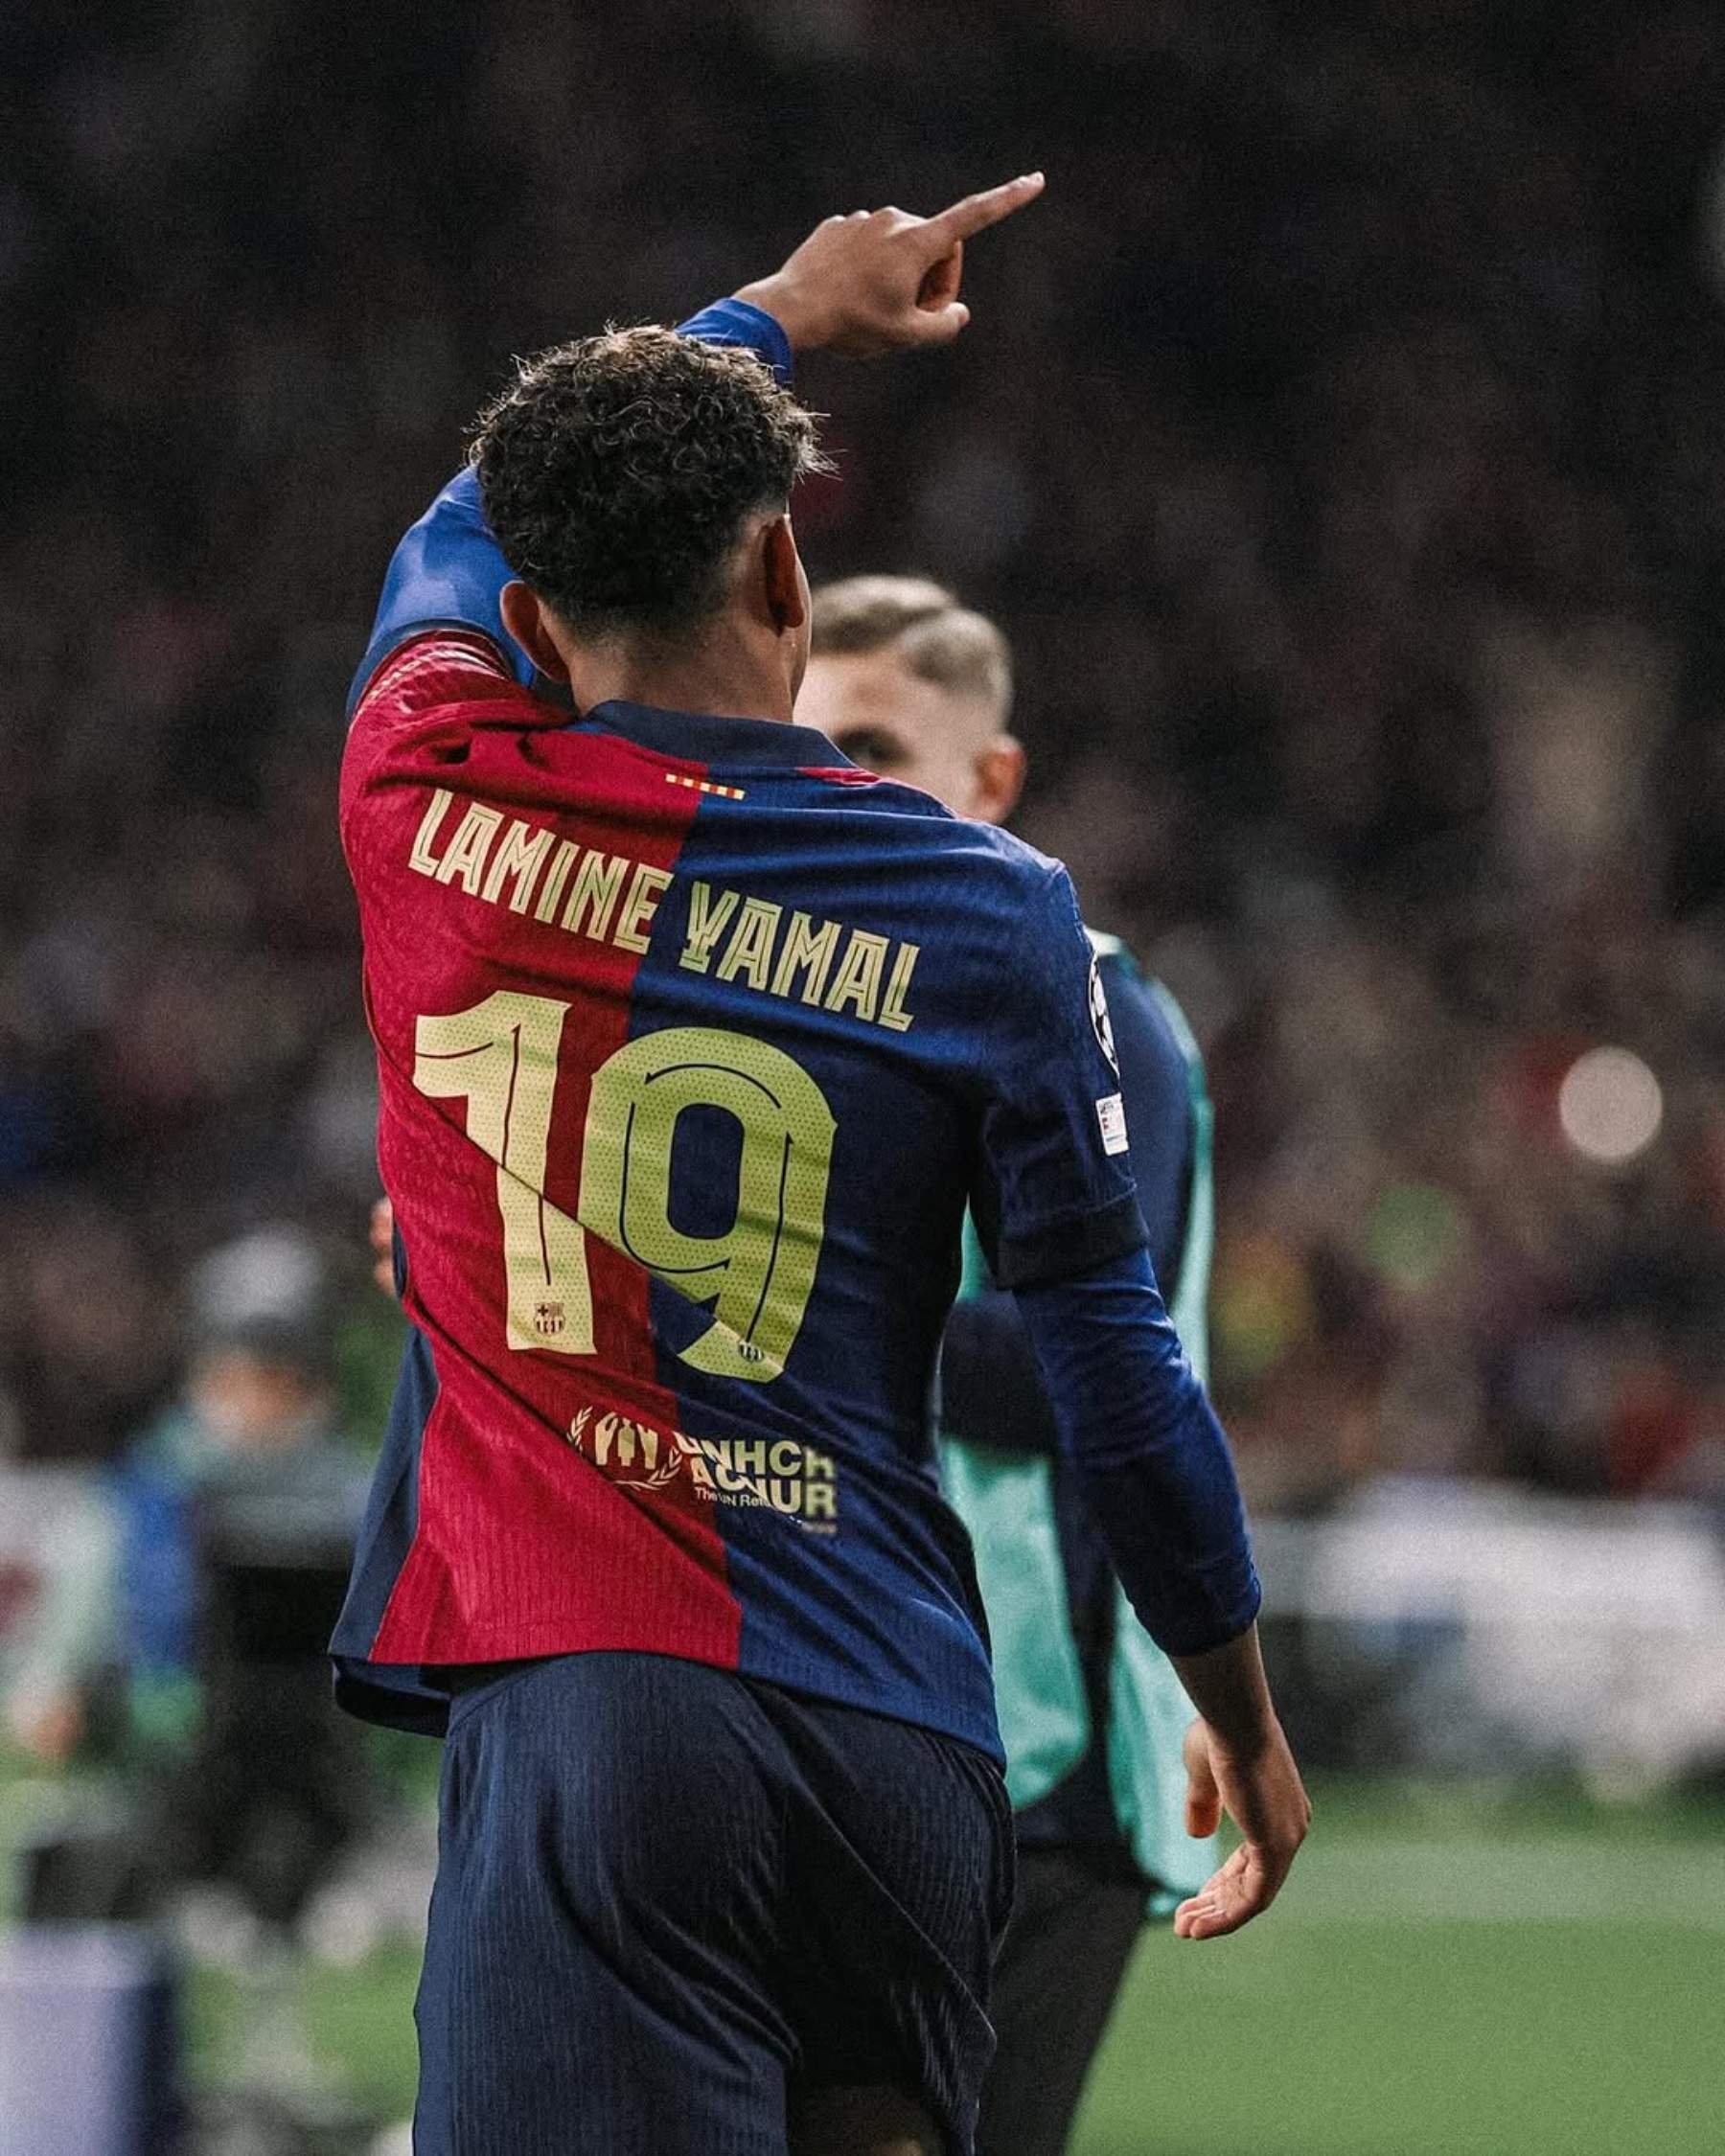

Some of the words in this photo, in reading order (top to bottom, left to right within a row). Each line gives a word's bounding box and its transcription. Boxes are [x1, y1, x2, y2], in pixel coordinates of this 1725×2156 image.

[408, 789, 674, 954] LAMINE
[678, 881, 920, 1032] YAMAL
[413, 990, 839, 1383] 19
